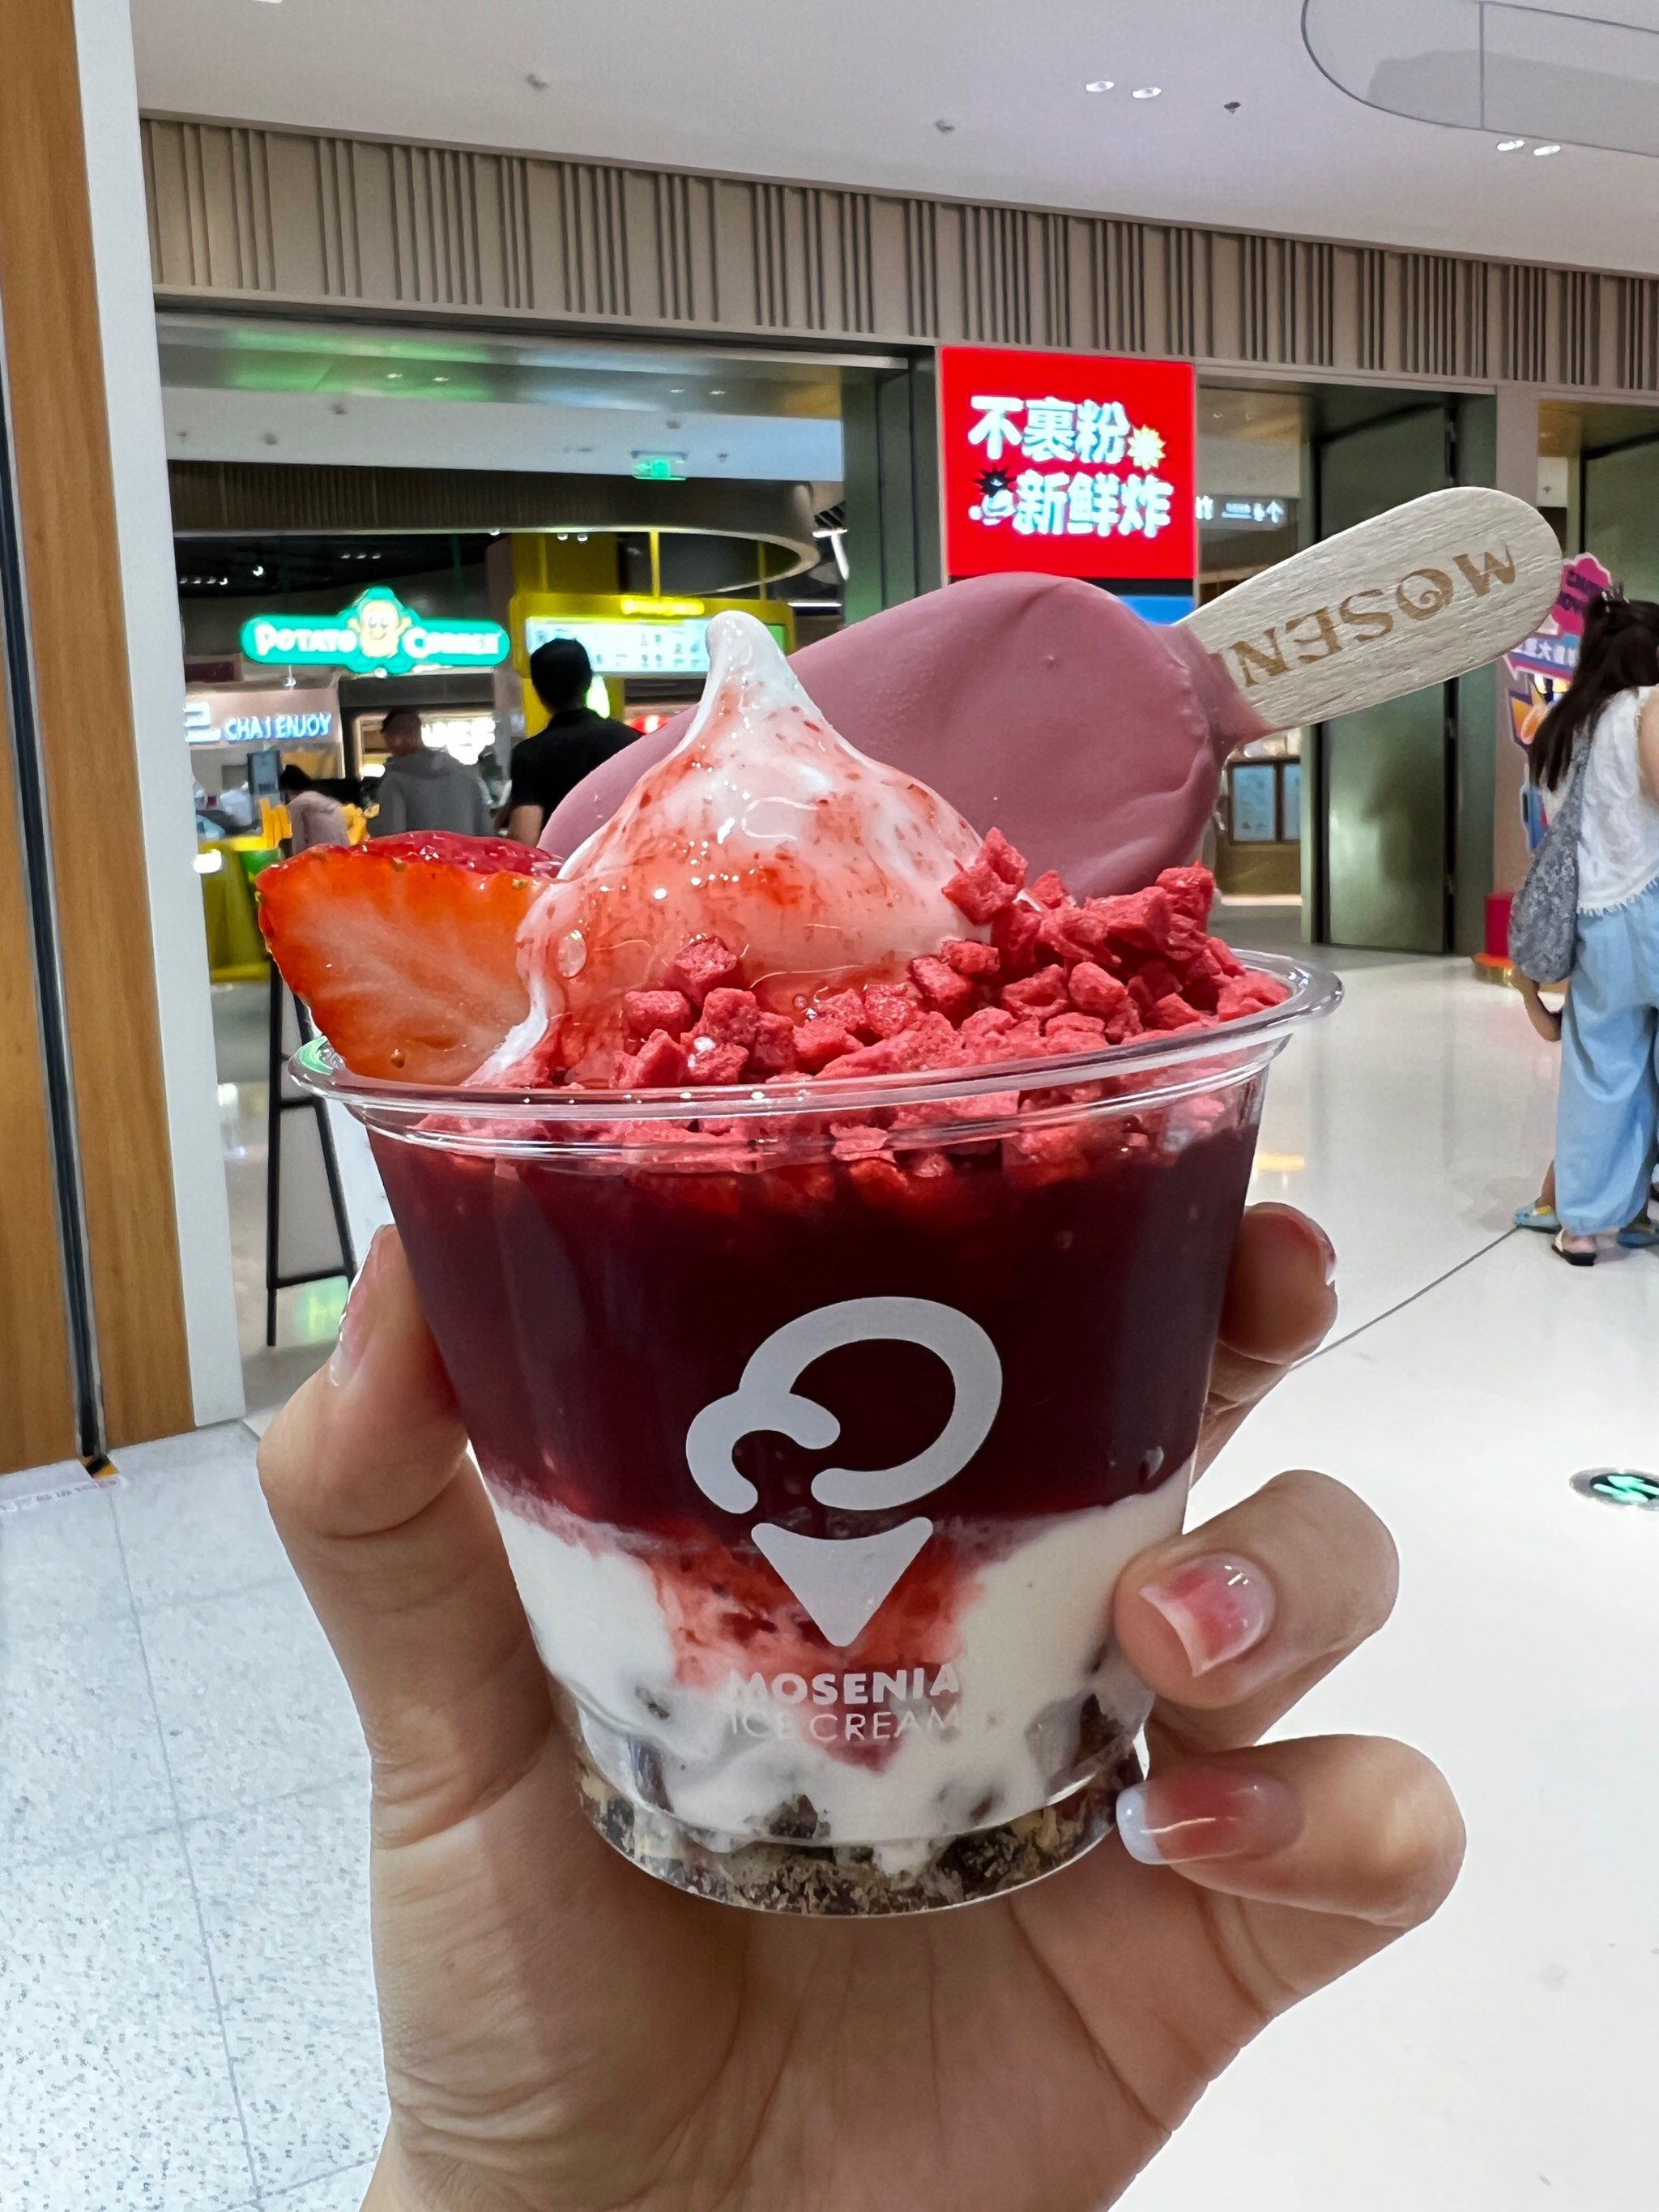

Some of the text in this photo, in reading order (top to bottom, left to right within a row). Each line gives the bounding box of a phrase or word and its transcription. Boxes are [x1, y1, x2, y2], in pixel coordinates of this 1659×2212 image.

[968, 395, 1129, 464] 不裹粉
[1013, 469, 1174, 538] 新鲜炸
[254, 623, 357, 656] POTATO
[275, 712, 332, 738] ENJOY
[729, 1663, 960, 1705] MOSENIA
[731, 1706, 958, 1742] ICE CREAM
